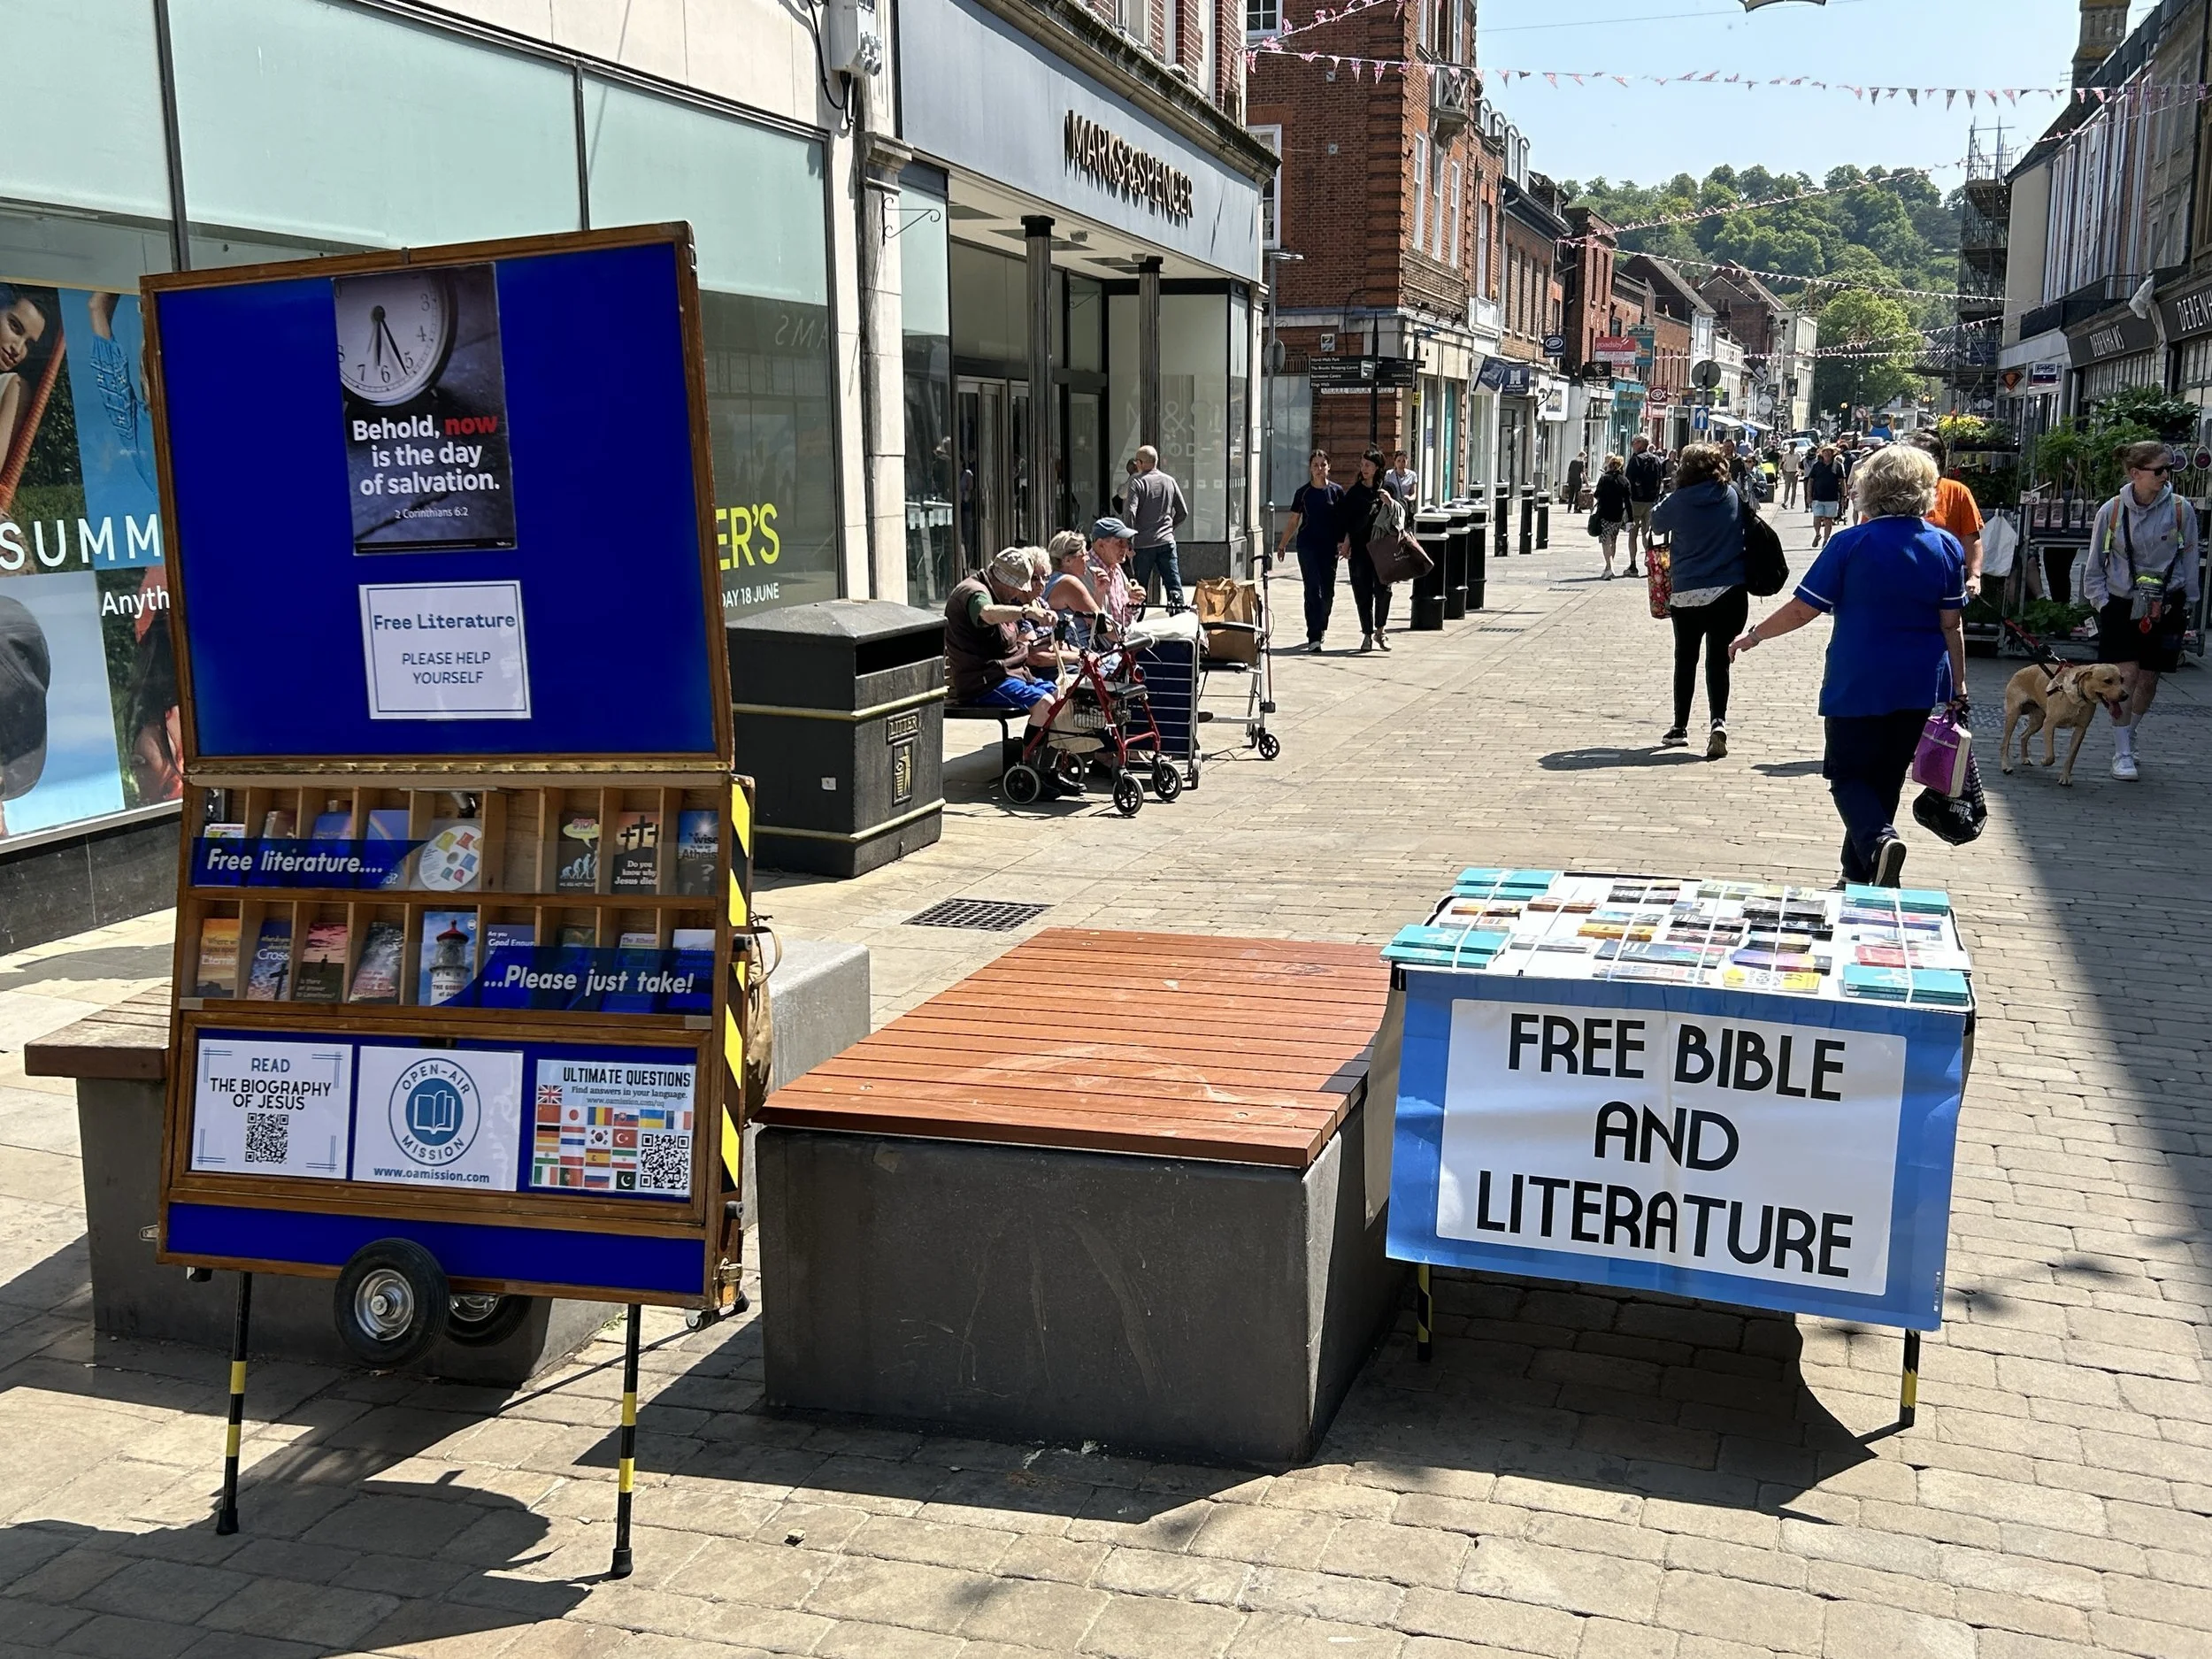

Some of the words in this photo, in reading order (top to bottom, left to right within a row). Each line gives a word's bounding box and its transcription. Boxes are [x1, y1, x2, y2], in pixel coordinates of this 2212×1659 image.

[352, 415, 441, 441] Behold,
[444, 416, 498, 436] now
[371, 445, 390, 468] is
[395, 443, 434, 466] the
[439, 442, 482, 468] day
[360, 472, 384, 495] of
[388, 468, 501, 495] salvation.
[395, 510, 402, 518] 2
[403, 507, 453, 518] Corinthians
[454, 507, 469, 517] 6:2
[0, 513, 161, 571] SUMM
[101, 585, 170, 619] Anyth
[741, 586, 752, 605] 18
[754, 582, 780, 603] JUNE
[373, 614, 413, 631] Free
[417, 613, 516, 629] Literature
[402, 652, 453, 665] PLEASE
[457, 651, 491, 664] HELP
[413, 671, 484, 684] YOURSELF
[889, 715, 918, 737] LITTER
[694, 832, 718, 844] wise
[206, 848, 253, 871] Free
[257, 949, 290, 961] Cross
[484, 964, 577, 990] ...Please
[585, 968, 629, 996] just
[637, 970, 694, 994] take!
[251, 1057, 290, 1072] READ
[1509, 1013, 1646, 1079] FREE
[1674, 1024, 1846, 1102] BIBLE
[211, 1078, 236, 1093] THE
[241, 1079, 332, 1097] BIOGRAPHY
[402, 1064, 471, 1094] OPEN-AIR
[563, 1066, 622, 1084] ULTIMATE
[626, 1070, 691, 1087] QUESTIONS
[233, 1094, 253, 1108] OF
[257, 1094, 305, 1110] JESUS
[589, 1087, 621, 1096] answers
[633, 1089, 649, 1098] your
[651, 1089, 687, 1099] language.
[1594, 1100, 1740, 1171] AND
[402, 1134, 465, 1160] MISSION
[373, 1167, 490, 1184] www.oamission.com
[1477, 1171, 1853, 1279] LITERATURE
